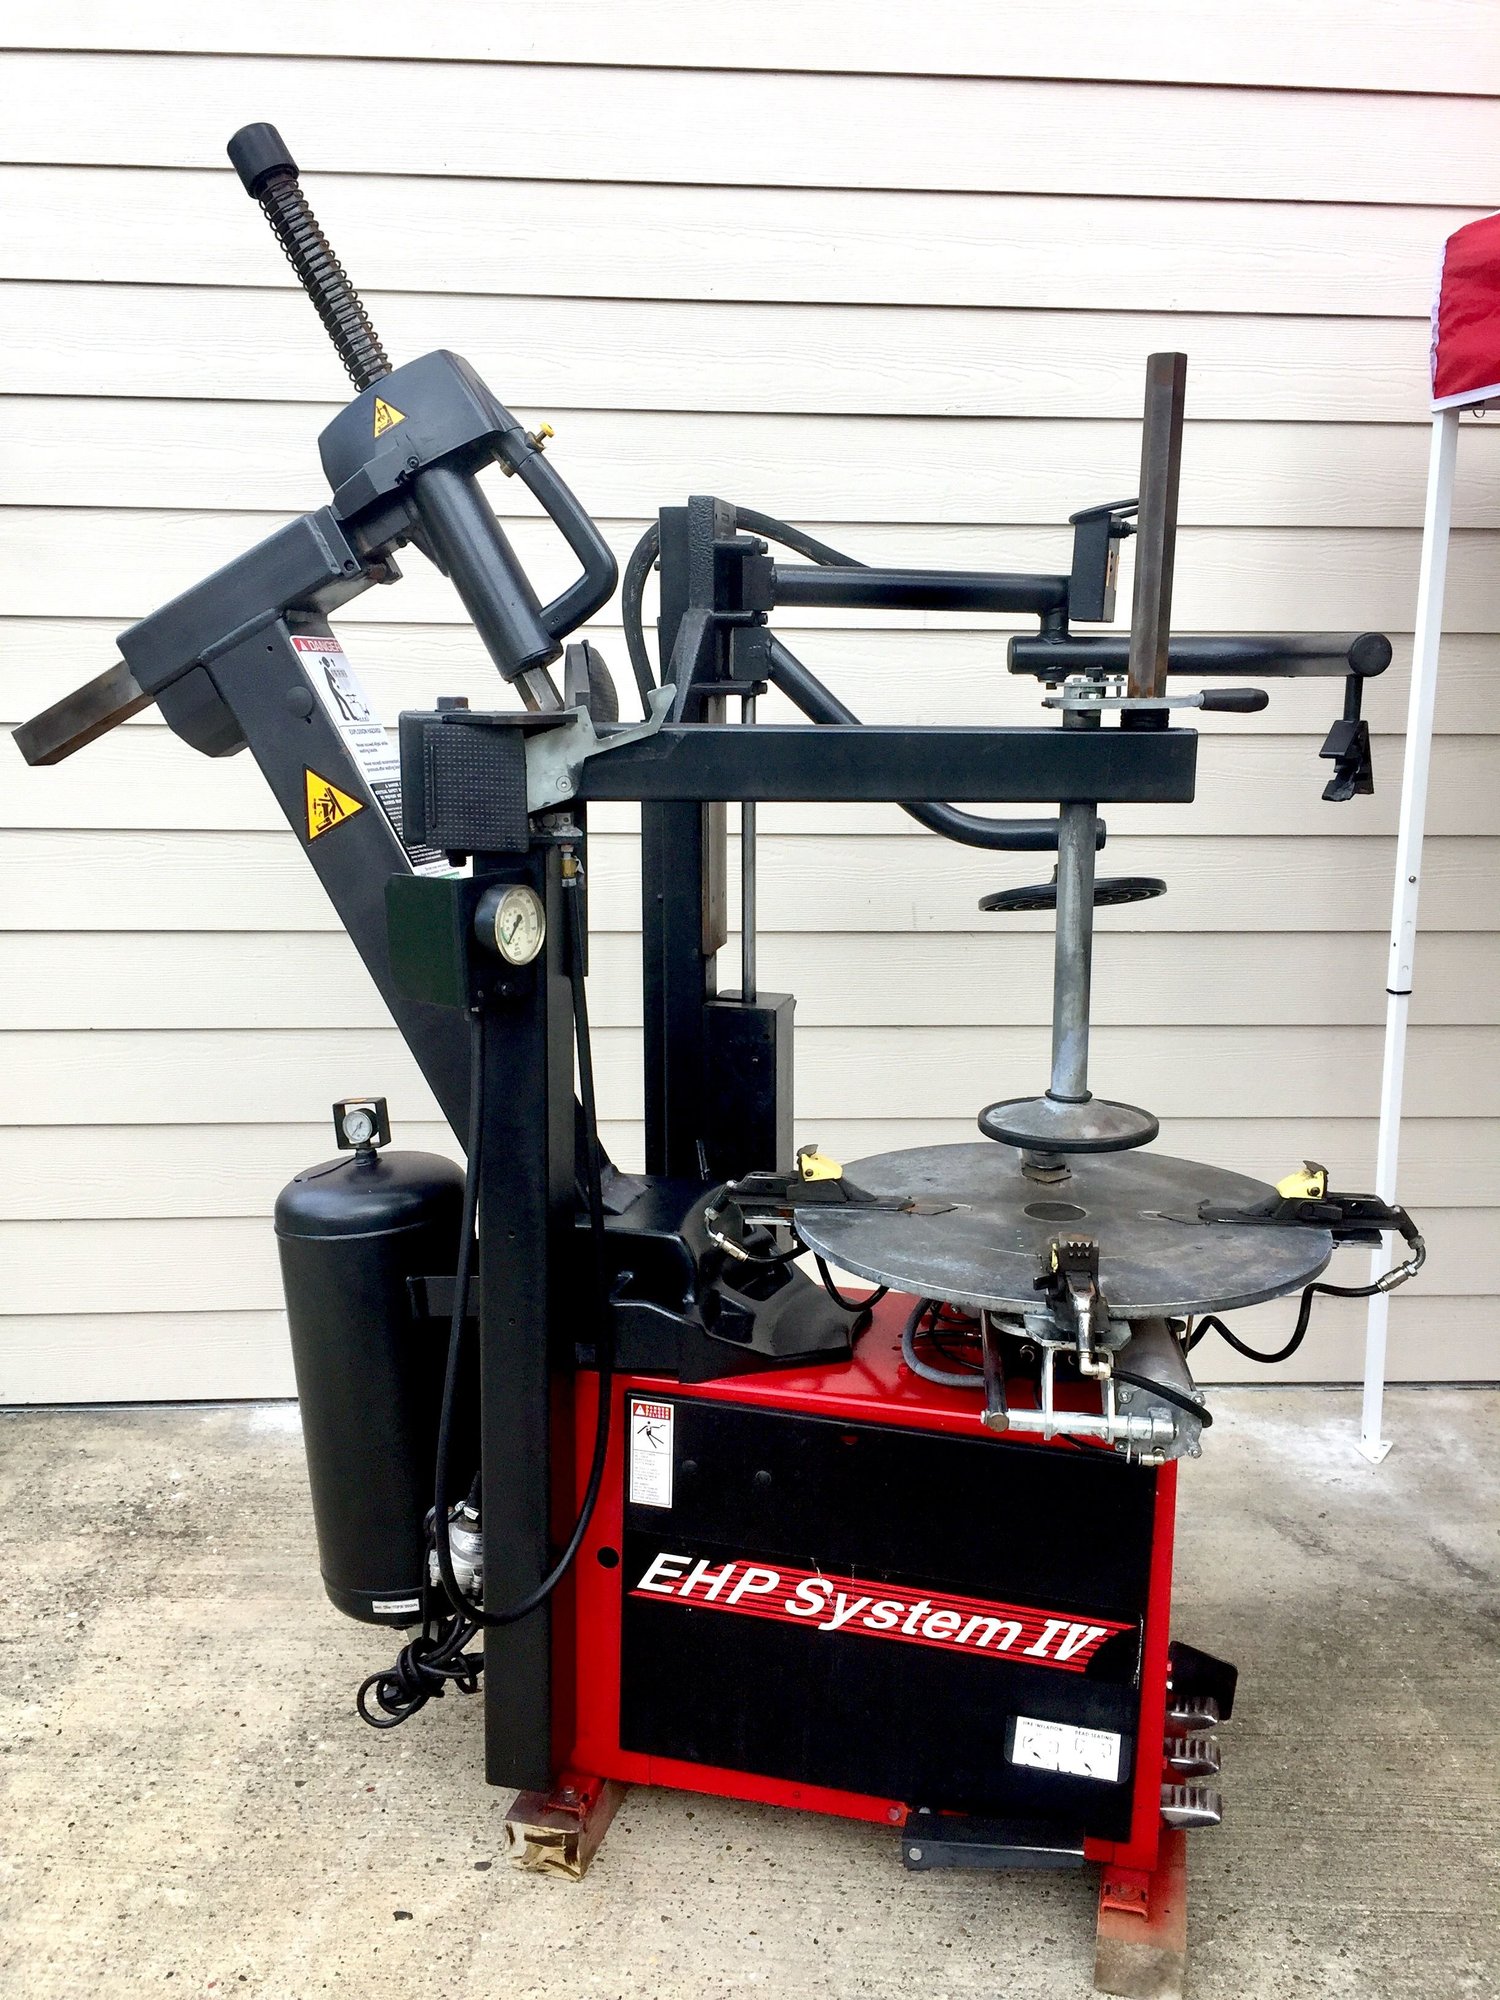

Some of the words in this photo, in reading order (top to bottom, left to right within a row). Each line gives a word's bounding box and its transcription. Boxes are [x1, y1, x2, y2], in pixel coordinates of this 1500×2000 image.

[636, 1553, 780, 1605] EHP
[784, 1577, 1023, 1651] System
[1022, 1618, 1107, 1662] IV
